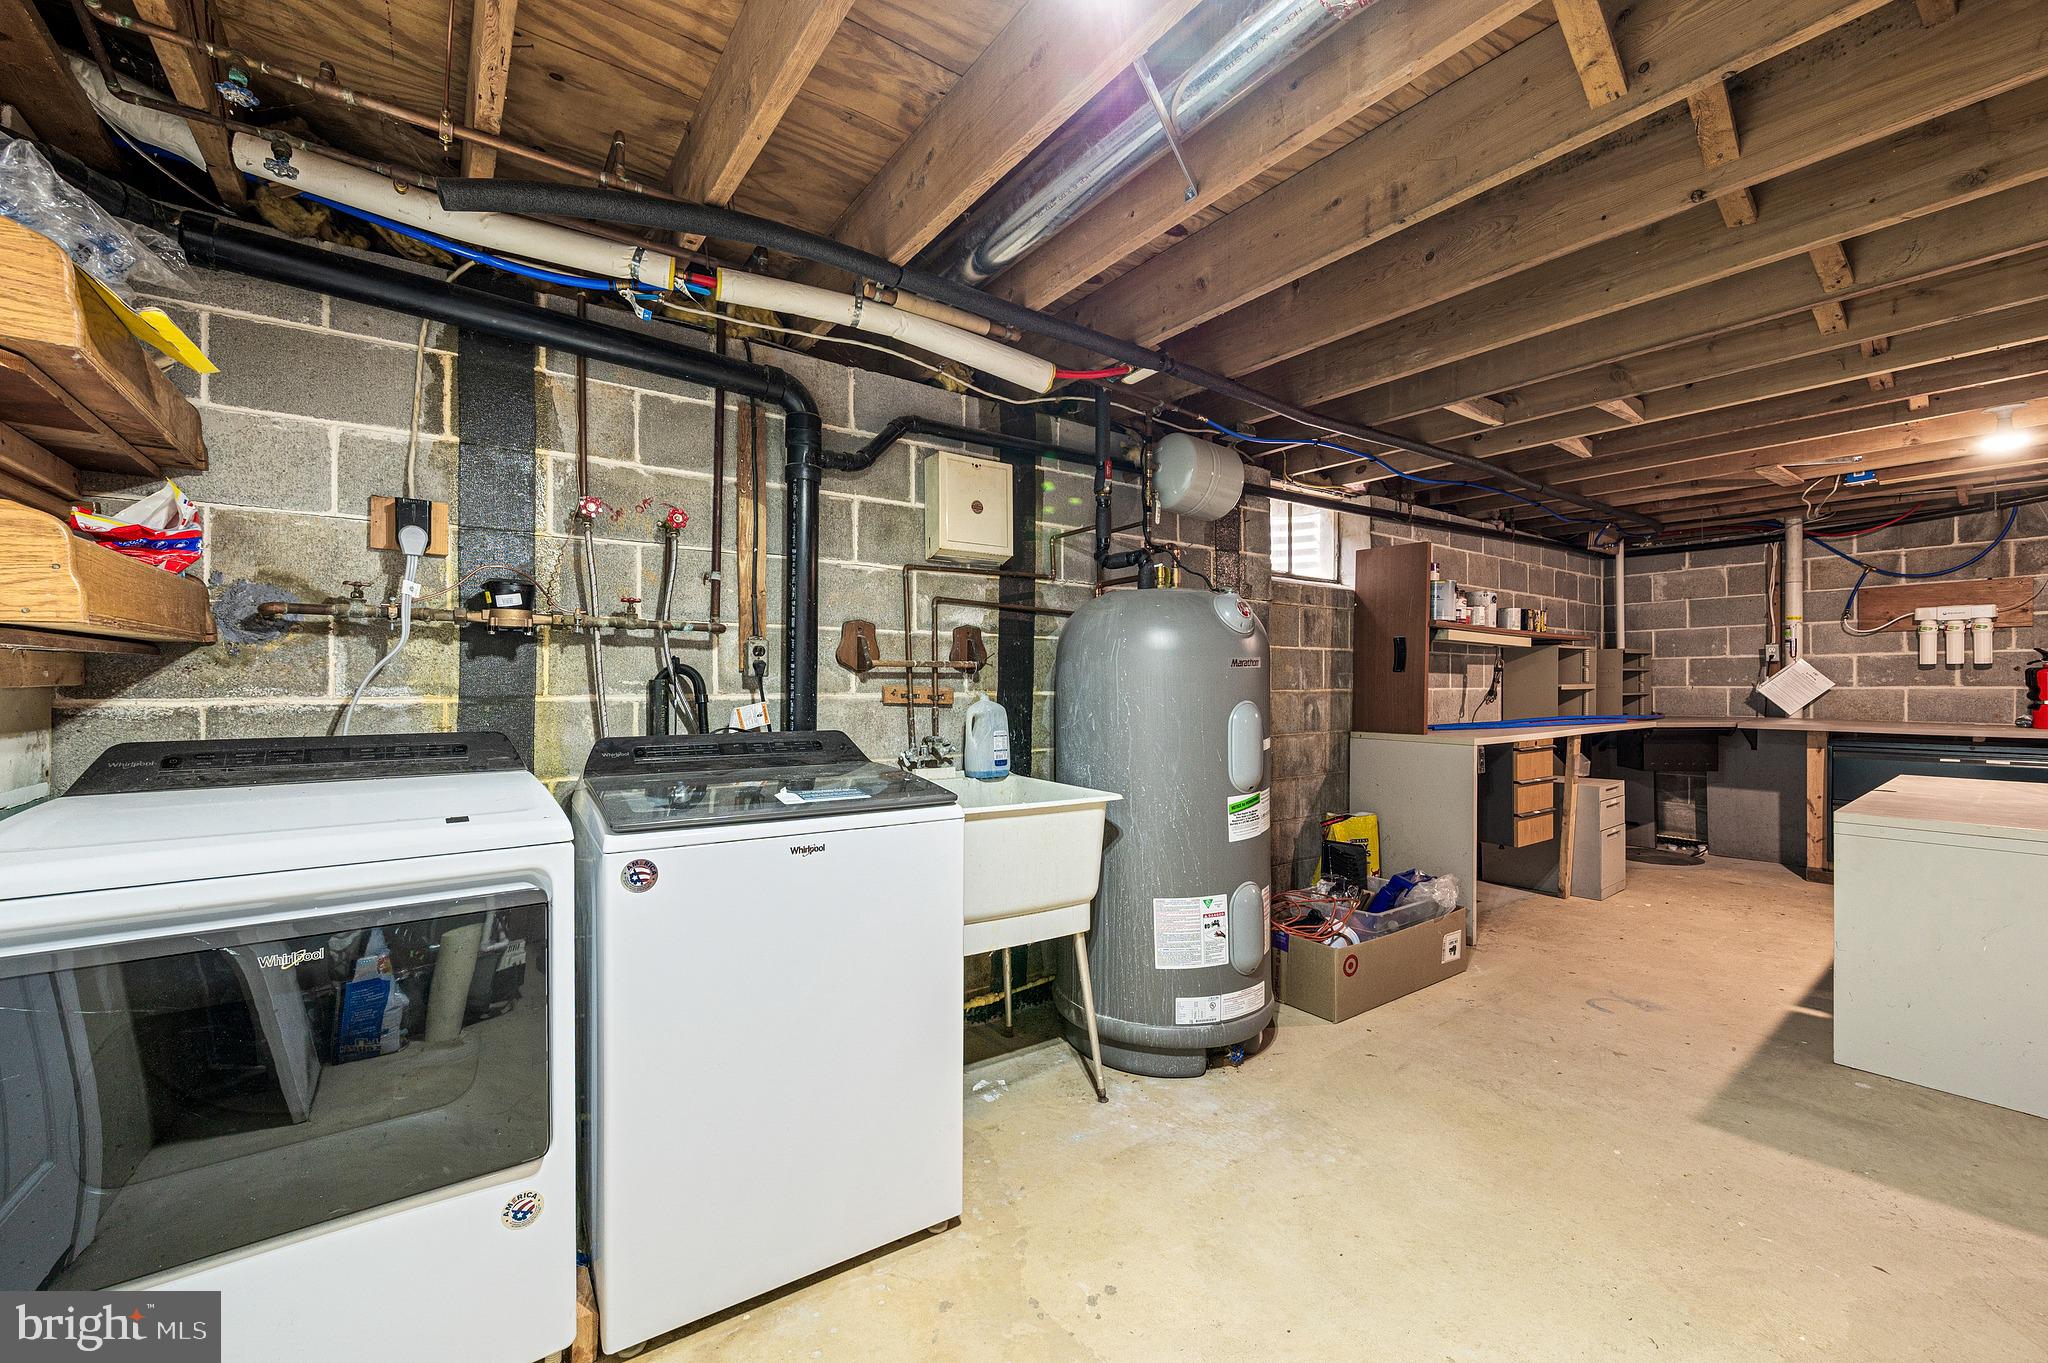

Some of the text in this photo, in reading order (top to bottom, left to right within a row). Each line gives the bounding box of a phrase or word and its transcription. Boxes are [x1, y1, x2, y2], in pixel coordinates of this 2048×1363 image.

[1231, 659, 1260, 668] Marathon
[601, 750, 630, 759] Whirlpool
[107, 759, 155, 769] Whirlpool
[790, 844, 826, 857] Whirlpool
[257, 947, 325, 970] Whirlpool
[503, 1192, 538, 1217] AMERICA
